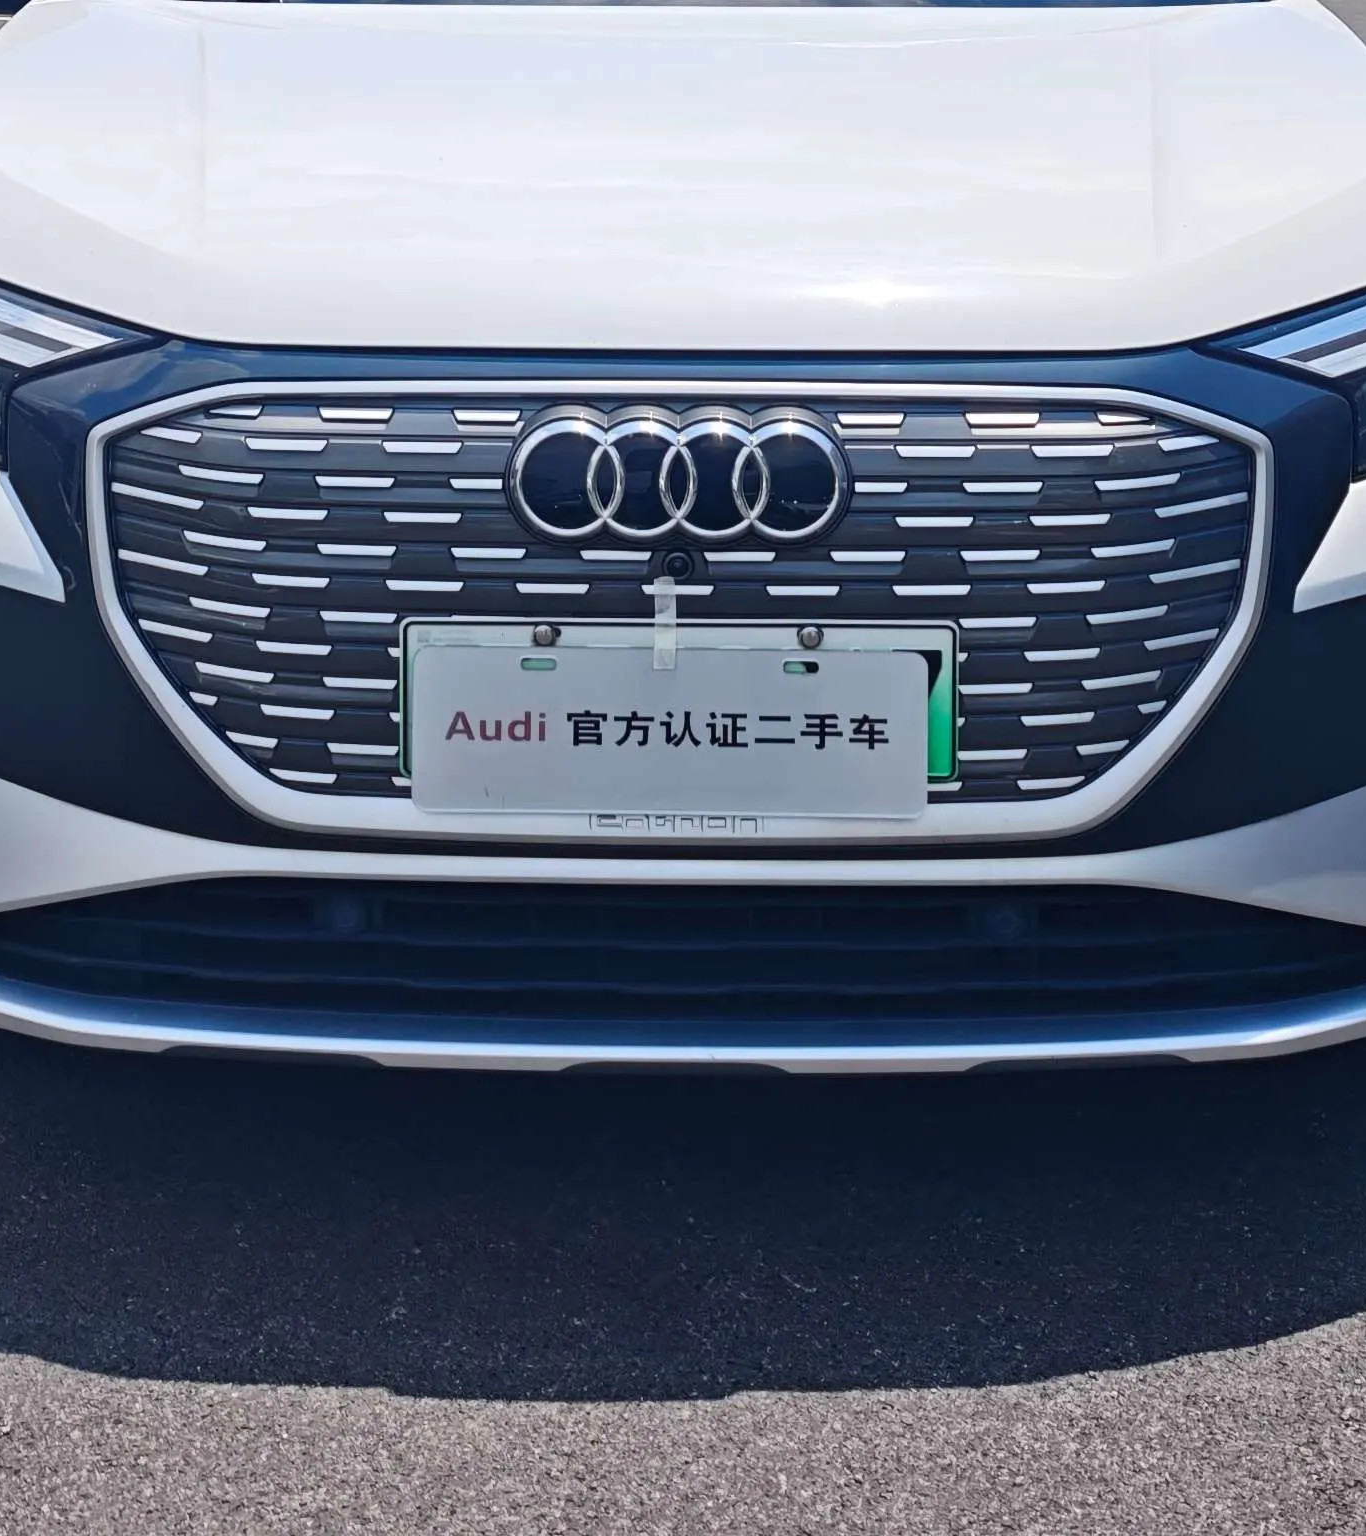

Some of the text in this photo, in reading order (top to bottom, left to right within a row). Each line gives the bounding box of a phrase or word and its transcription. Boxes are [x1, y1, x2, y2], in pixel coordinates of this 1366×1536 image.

[445, 710, 889, 750] Audi 官方认证二手车
